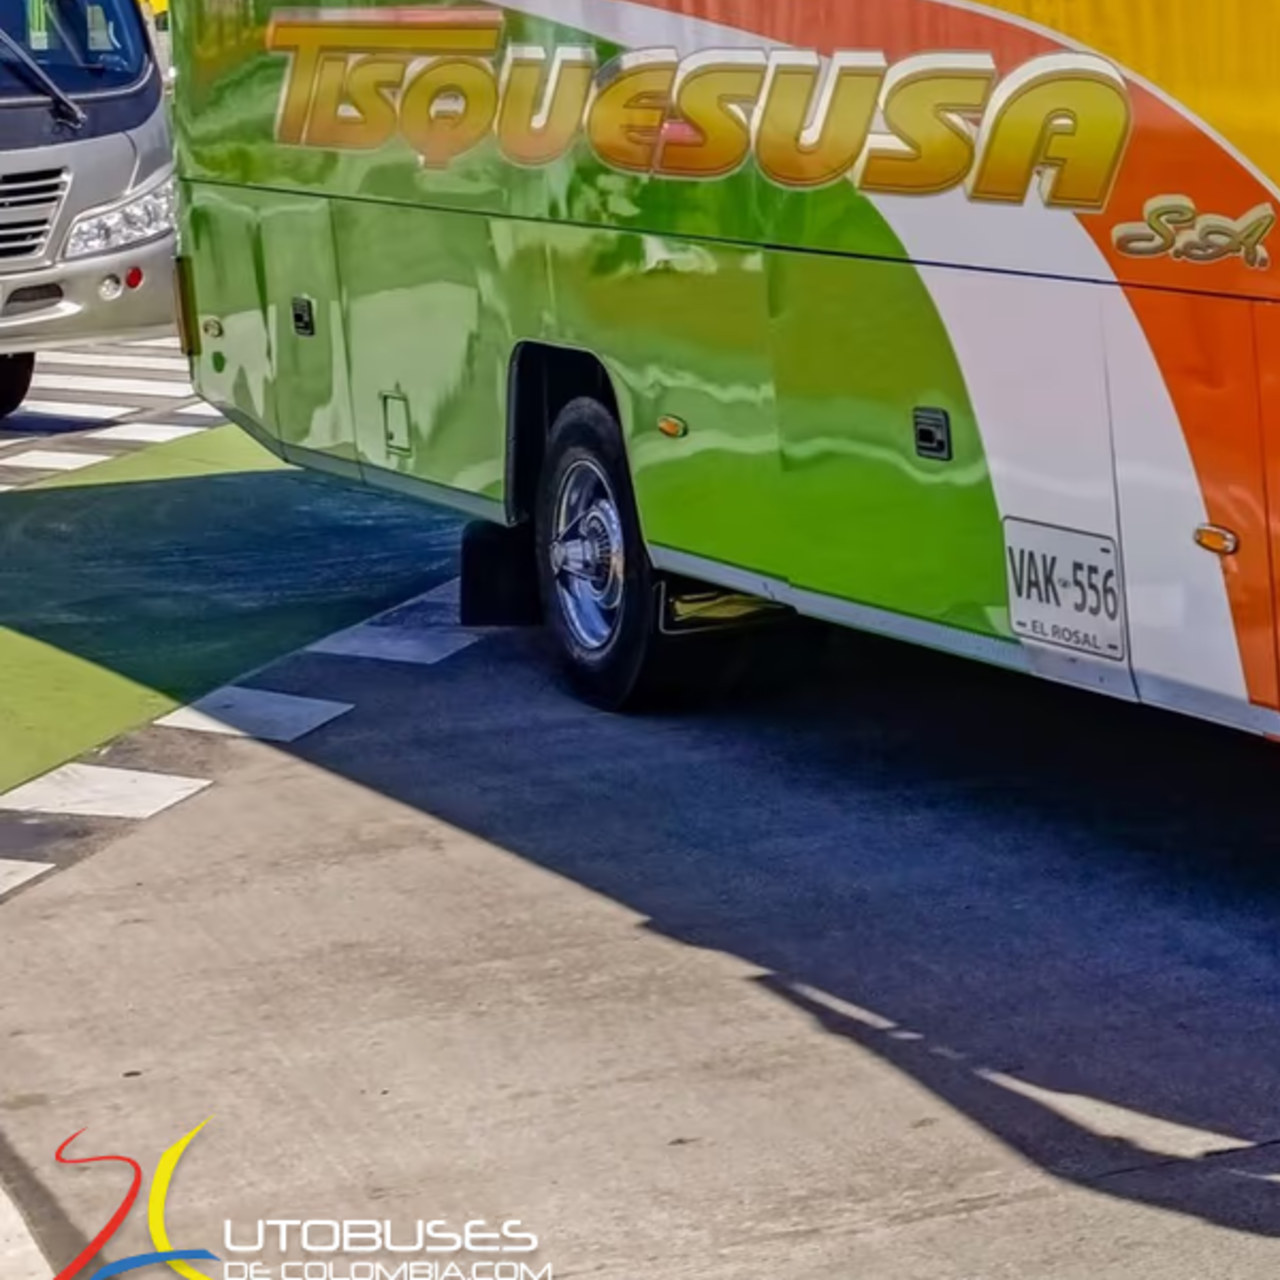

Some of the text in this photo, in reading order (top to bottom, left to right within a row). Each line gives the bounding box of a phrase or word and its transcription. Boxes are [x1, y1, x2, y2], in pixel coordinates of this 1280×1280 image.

[264, 6, 1133, 214] TISQUESUSA
[1031, 619, 1101, 650] EL ROSAL
